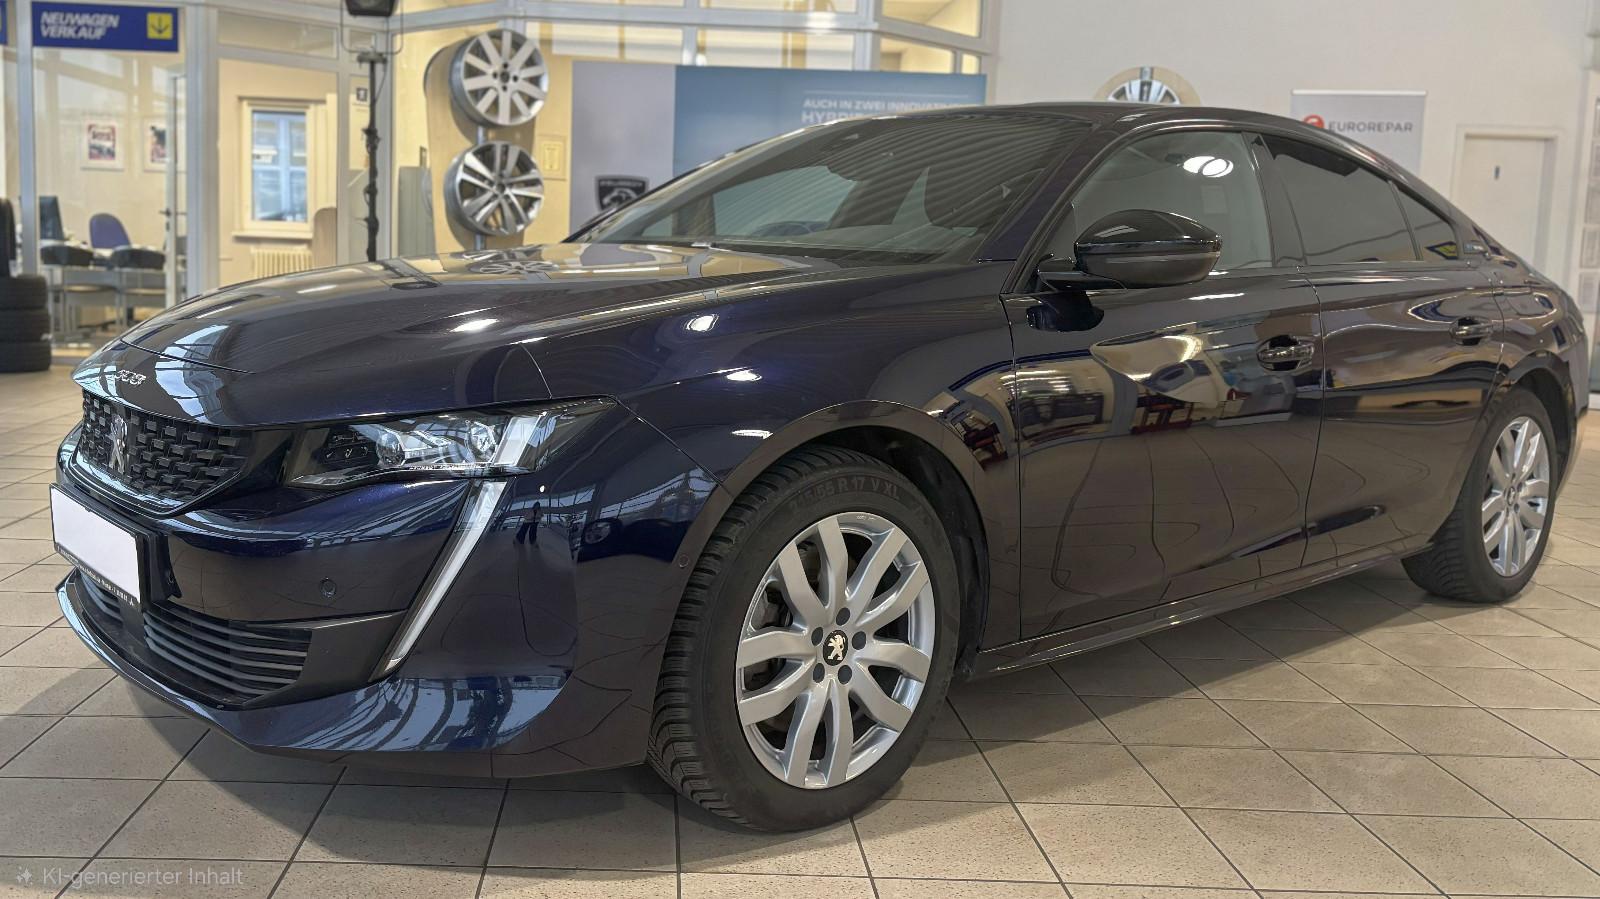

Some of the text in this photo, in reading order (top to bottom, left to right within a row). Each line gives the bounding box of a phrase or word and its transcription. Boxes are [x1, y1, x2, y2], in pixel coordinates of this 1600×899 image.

[40, 11, 120, 28] NEUWAGEN
[40, 24, 107, 40] VERKAUF
[803, 99, 837, 109] AUCH
[839, 100, 851, 109] IN
[855, 101, 885, 110] ZWEI
[1328, 121, 1414, 132] EUROREPAR
